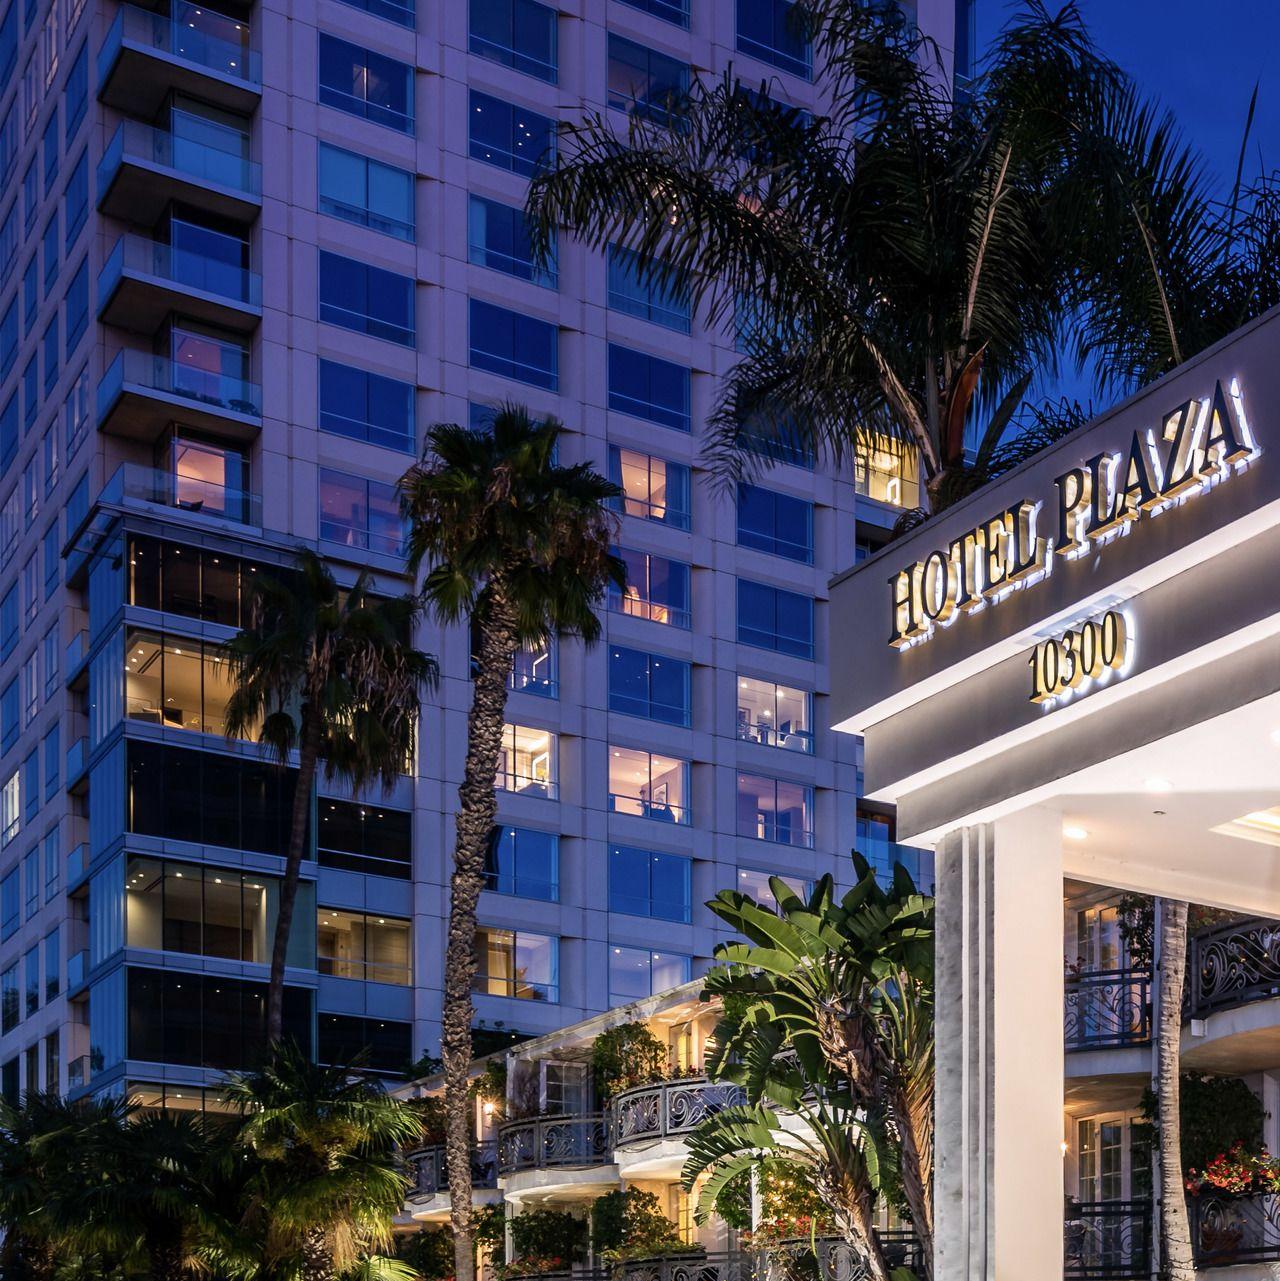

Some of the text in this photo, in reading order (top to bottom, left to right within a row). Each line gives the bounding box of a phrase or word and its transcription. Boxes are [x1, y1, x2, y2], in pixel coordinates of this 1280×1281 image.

[887, 378, 1260, 650] HOTEL PLAZA
[1028, 608, 1134, 705] 10300
